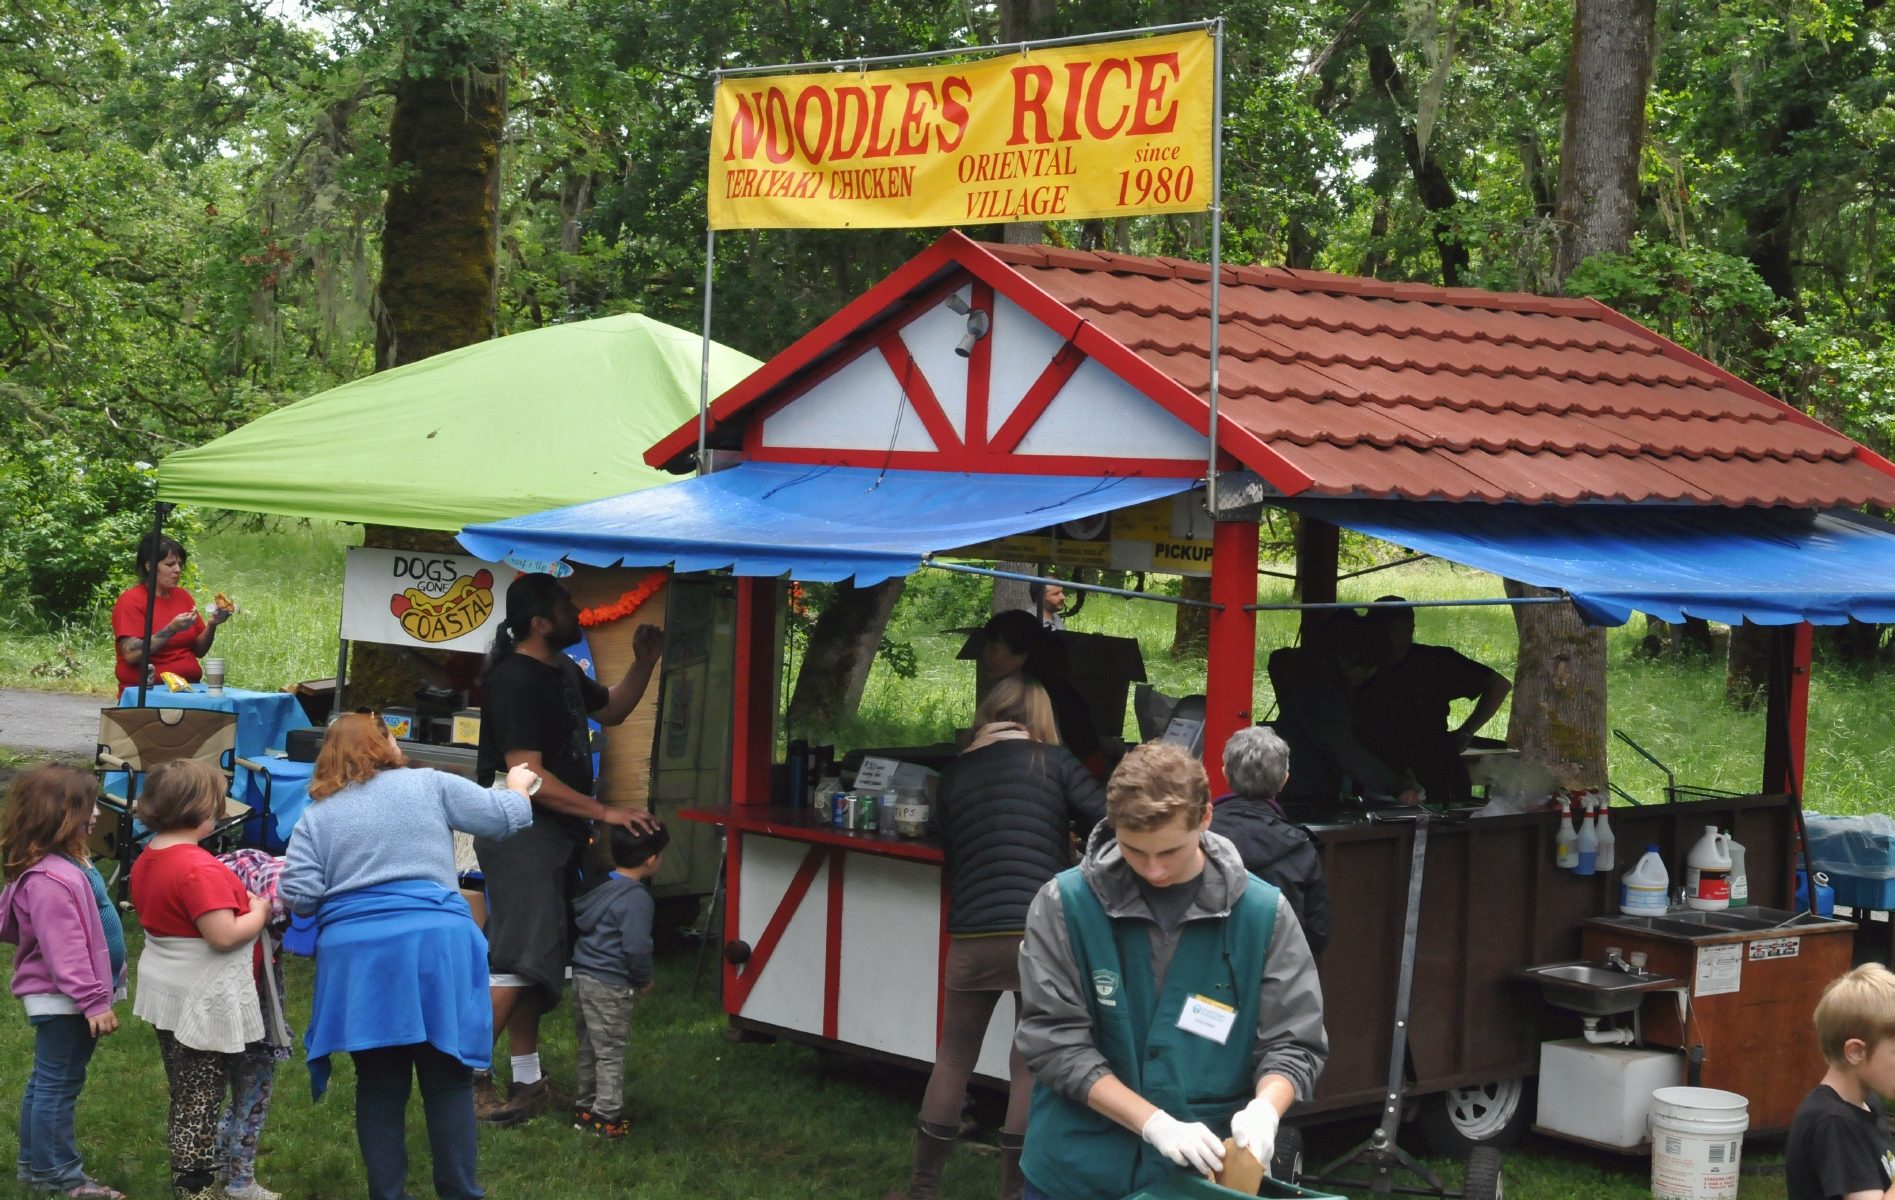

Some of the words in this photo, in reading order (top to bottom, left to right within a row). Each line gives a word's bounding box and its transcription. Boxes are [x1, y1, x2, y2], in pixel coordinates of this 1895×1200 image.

[724, 76, 972, 164] NOODLES
[1006, 52, 1179, 145] RICE
[958, 146, 1077, 183] ORIENTAL
[1135, 145, 1179, 162] since
[725, 166, 823, 199] TERIYAKI
[828, 166, 916, 199] CHICKEN
[1116, 165, 1194, 206] 1980
[966, 185, 1069, 218] VILLAGE
[394, 556, 457, 581] DOGS
[1156, 543, 1213, 561] PICKUP
[417, 580, 450, 593] GONE
[402, 594, 492, 638] COASTAL
